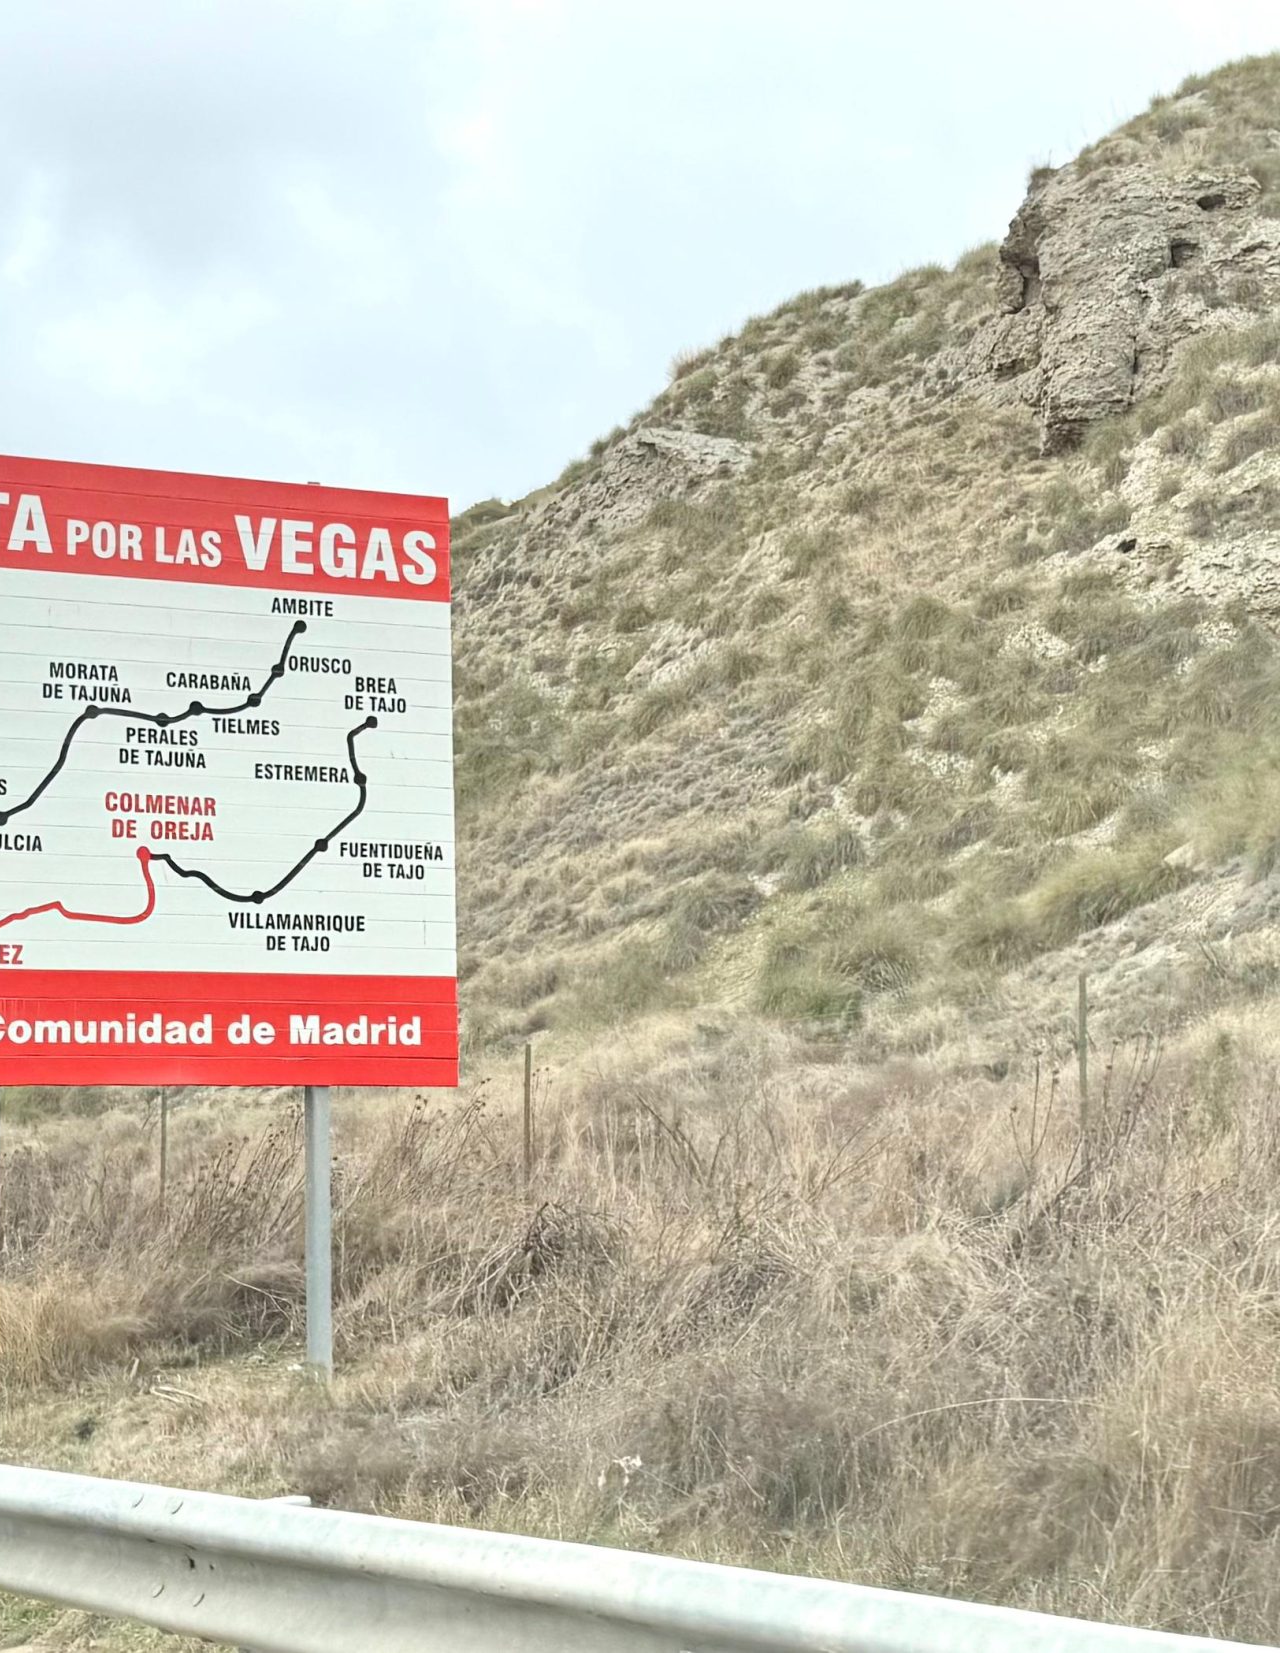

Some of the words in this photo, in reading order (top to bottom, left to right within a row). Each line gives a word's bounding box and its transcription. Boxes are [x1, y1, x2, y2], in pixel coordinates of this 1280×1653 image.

[66, 518, 144, 561] POR
[155, 526, 222, 568] LAS
[233, 514, 437, 586] VEGAS
[271, 597, 334, 618] AMBITE
[49, 661, 119, 682] MORATA
[288, 655, 352, 675] ORUSCO
[166, 671, 252, 692] CARABAÑA
[355, 676, 397, 696] BREA
[42, 682, 64, 700] DE
[68, 682, 132, 704] TAJUÑA
[344, 694, 364, 711] DE
[369, 696, 407, 715] TAJO
[126, 726, 200, 747] PERALES
[211, 717, 280, 736] TIELMES
[119, 747, 140, 765] DE
[144, 748, 207, 769] TAJUÑA
[254, 763, 350, 784] ESTREMERA
[105, 792, 216, 815] COLMENAR
[112, 819, 135, 839] DE
[151, 820, 213, 841] OREJA
[339, 841, 444, 863] FUENTIDUEÑA
[362, 862, 383, 878] DE
[386, 863, 425, 880] TAJO
[228, 911, 366, 935] VILLAMANRIQUE
[266, 935, 286, 951] DE
[291, 935, 330, 952] TAJO
[227, 1013, 276, 1045] de
[289, 1014, 422, 1046] Madrid
